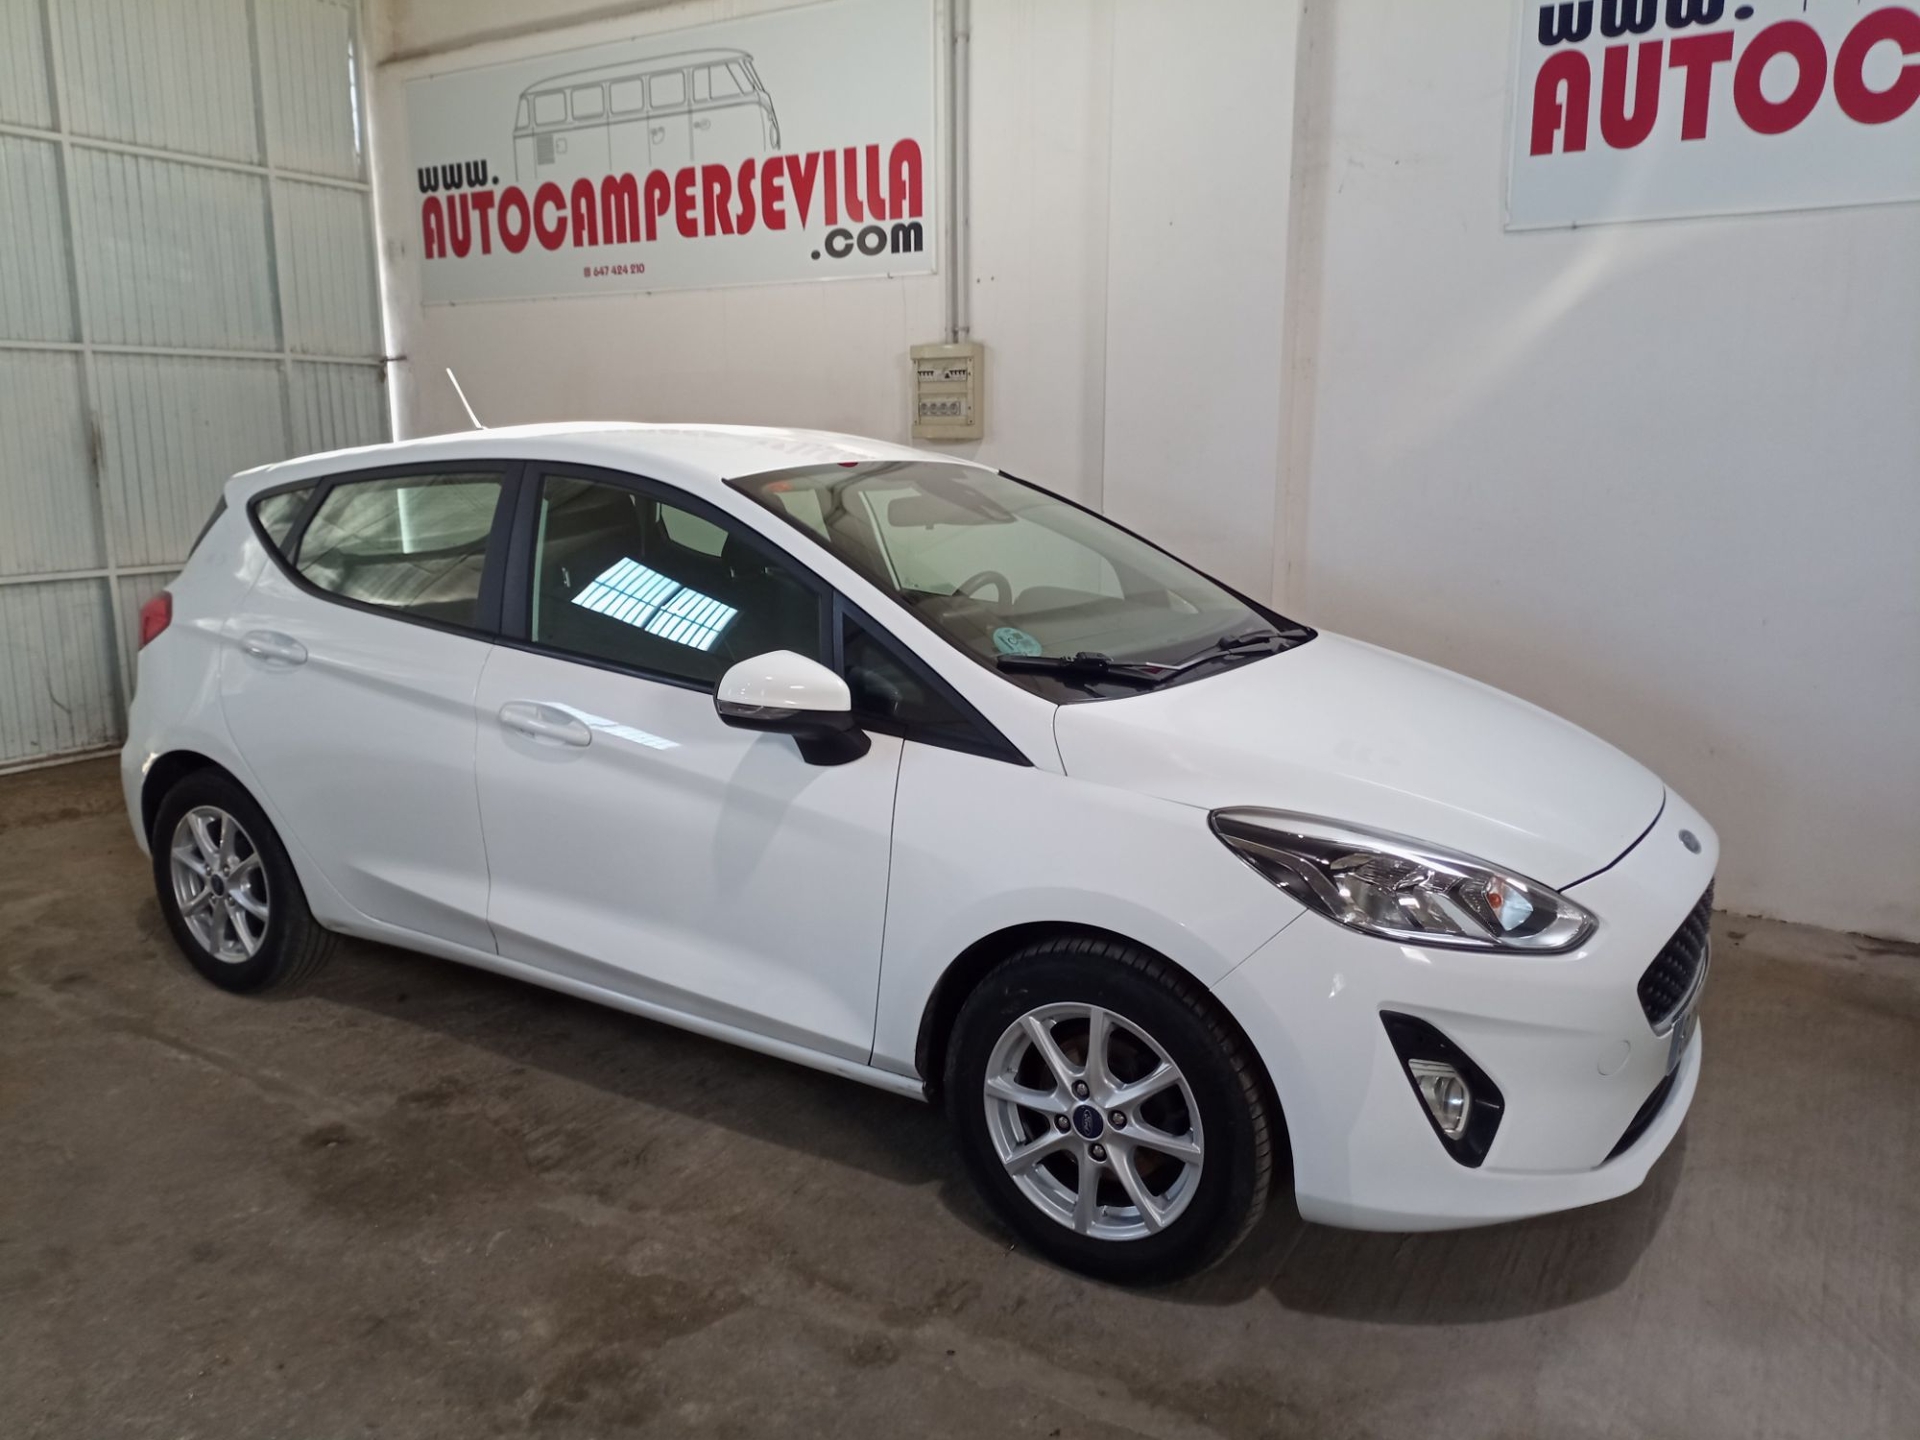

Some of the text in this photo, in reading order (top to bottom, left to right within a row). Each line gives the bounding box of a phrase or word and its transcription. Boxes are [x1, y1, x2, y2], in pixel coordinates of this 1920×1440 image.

[417, 159, 501, 194] www.
[421, 138, 924, 260] AUTOCAMPERSEVILLA
[810, 221, 924, 261] .com
[593, 262, 645, 277] 647 424 210
